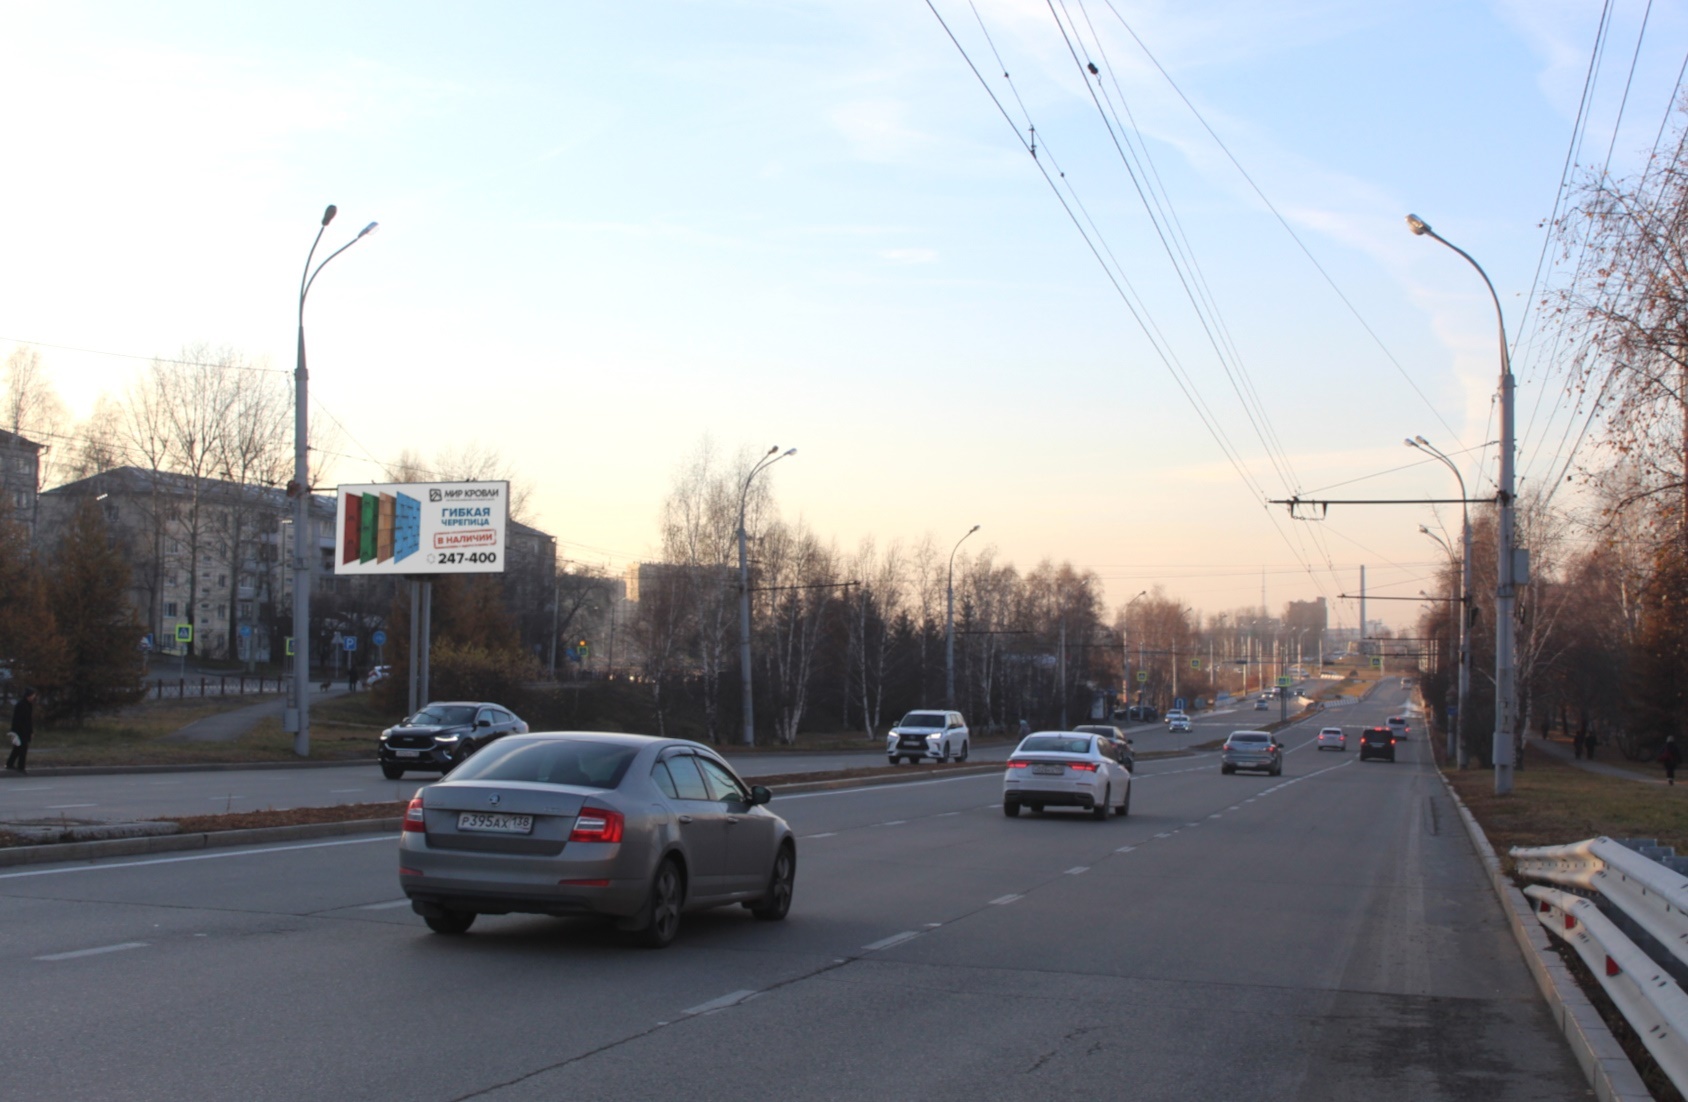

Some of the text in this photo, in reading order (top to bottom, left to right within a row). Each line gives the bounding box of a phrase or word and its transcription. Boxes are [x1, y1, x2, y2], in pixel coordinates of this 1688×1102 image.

[464, 489, 499, 497] КРОВЛИ
[442, 508, 490, 517] ГИБКАЯ
[441, 518, 490, 526] ЧЕРЕПИЦА
[446, 534, 492, 544] НАЛИЧИИ
[438, 552, 496, 564] 247-400
